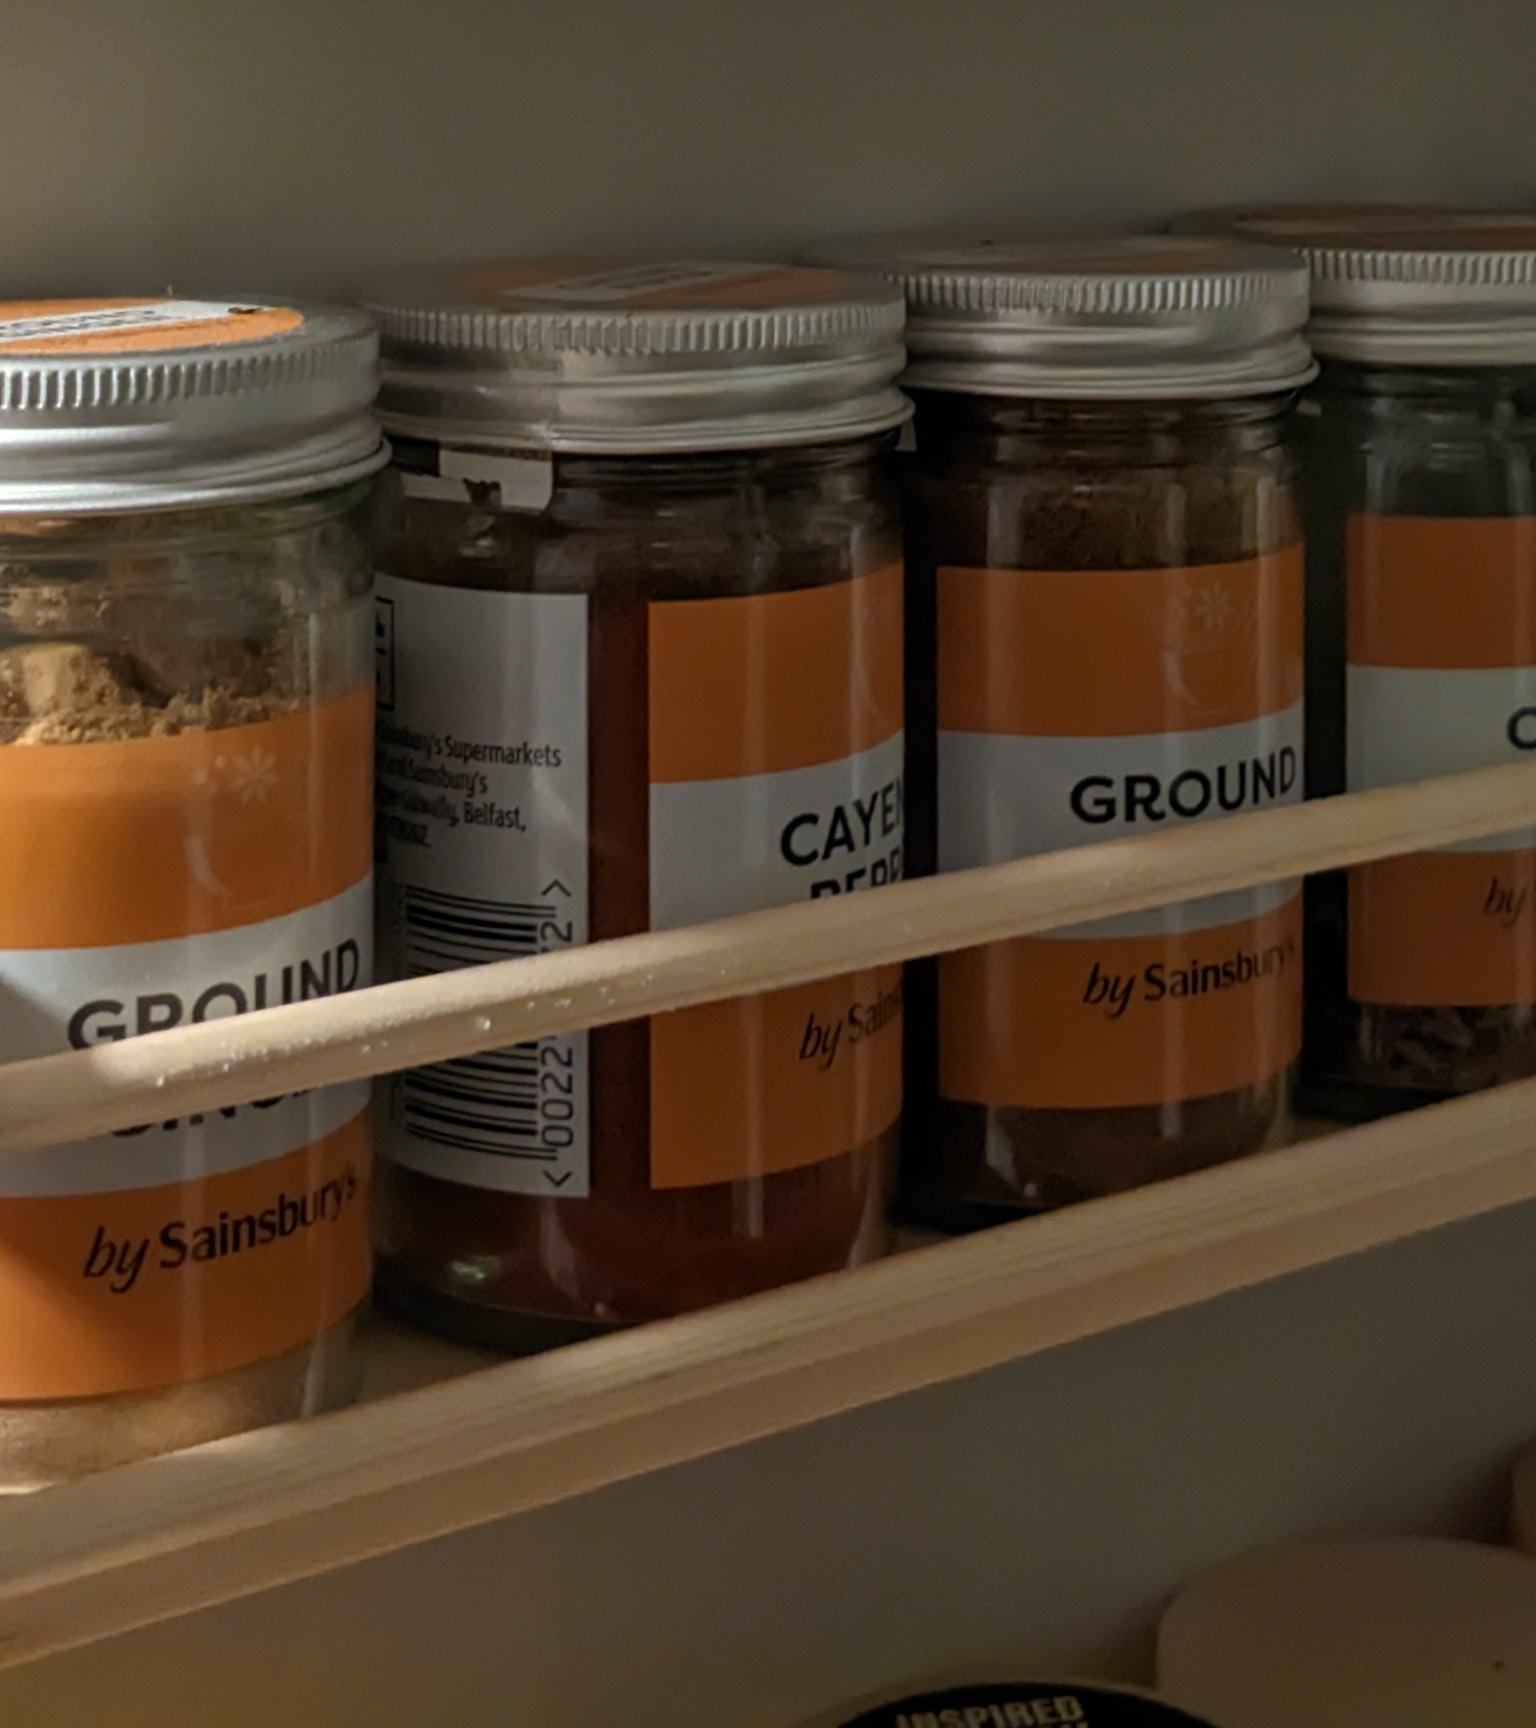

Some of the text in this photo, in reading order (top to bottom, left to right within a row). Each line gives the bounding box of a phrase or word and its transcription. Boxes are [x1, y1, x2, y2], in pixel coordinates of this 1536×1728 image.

[444, 735, 563, 768] Supermarkets
[1069, 744, 1297, 824] GROUND
[463, 801, 527, 833] Belfast,
[1482, 877, 1529, 928] by
[1082, 962, 1136, 1019] by
[799, 1011, 843, 1071] by
[82, 1160, 358, 1294] by Sainsbury's
